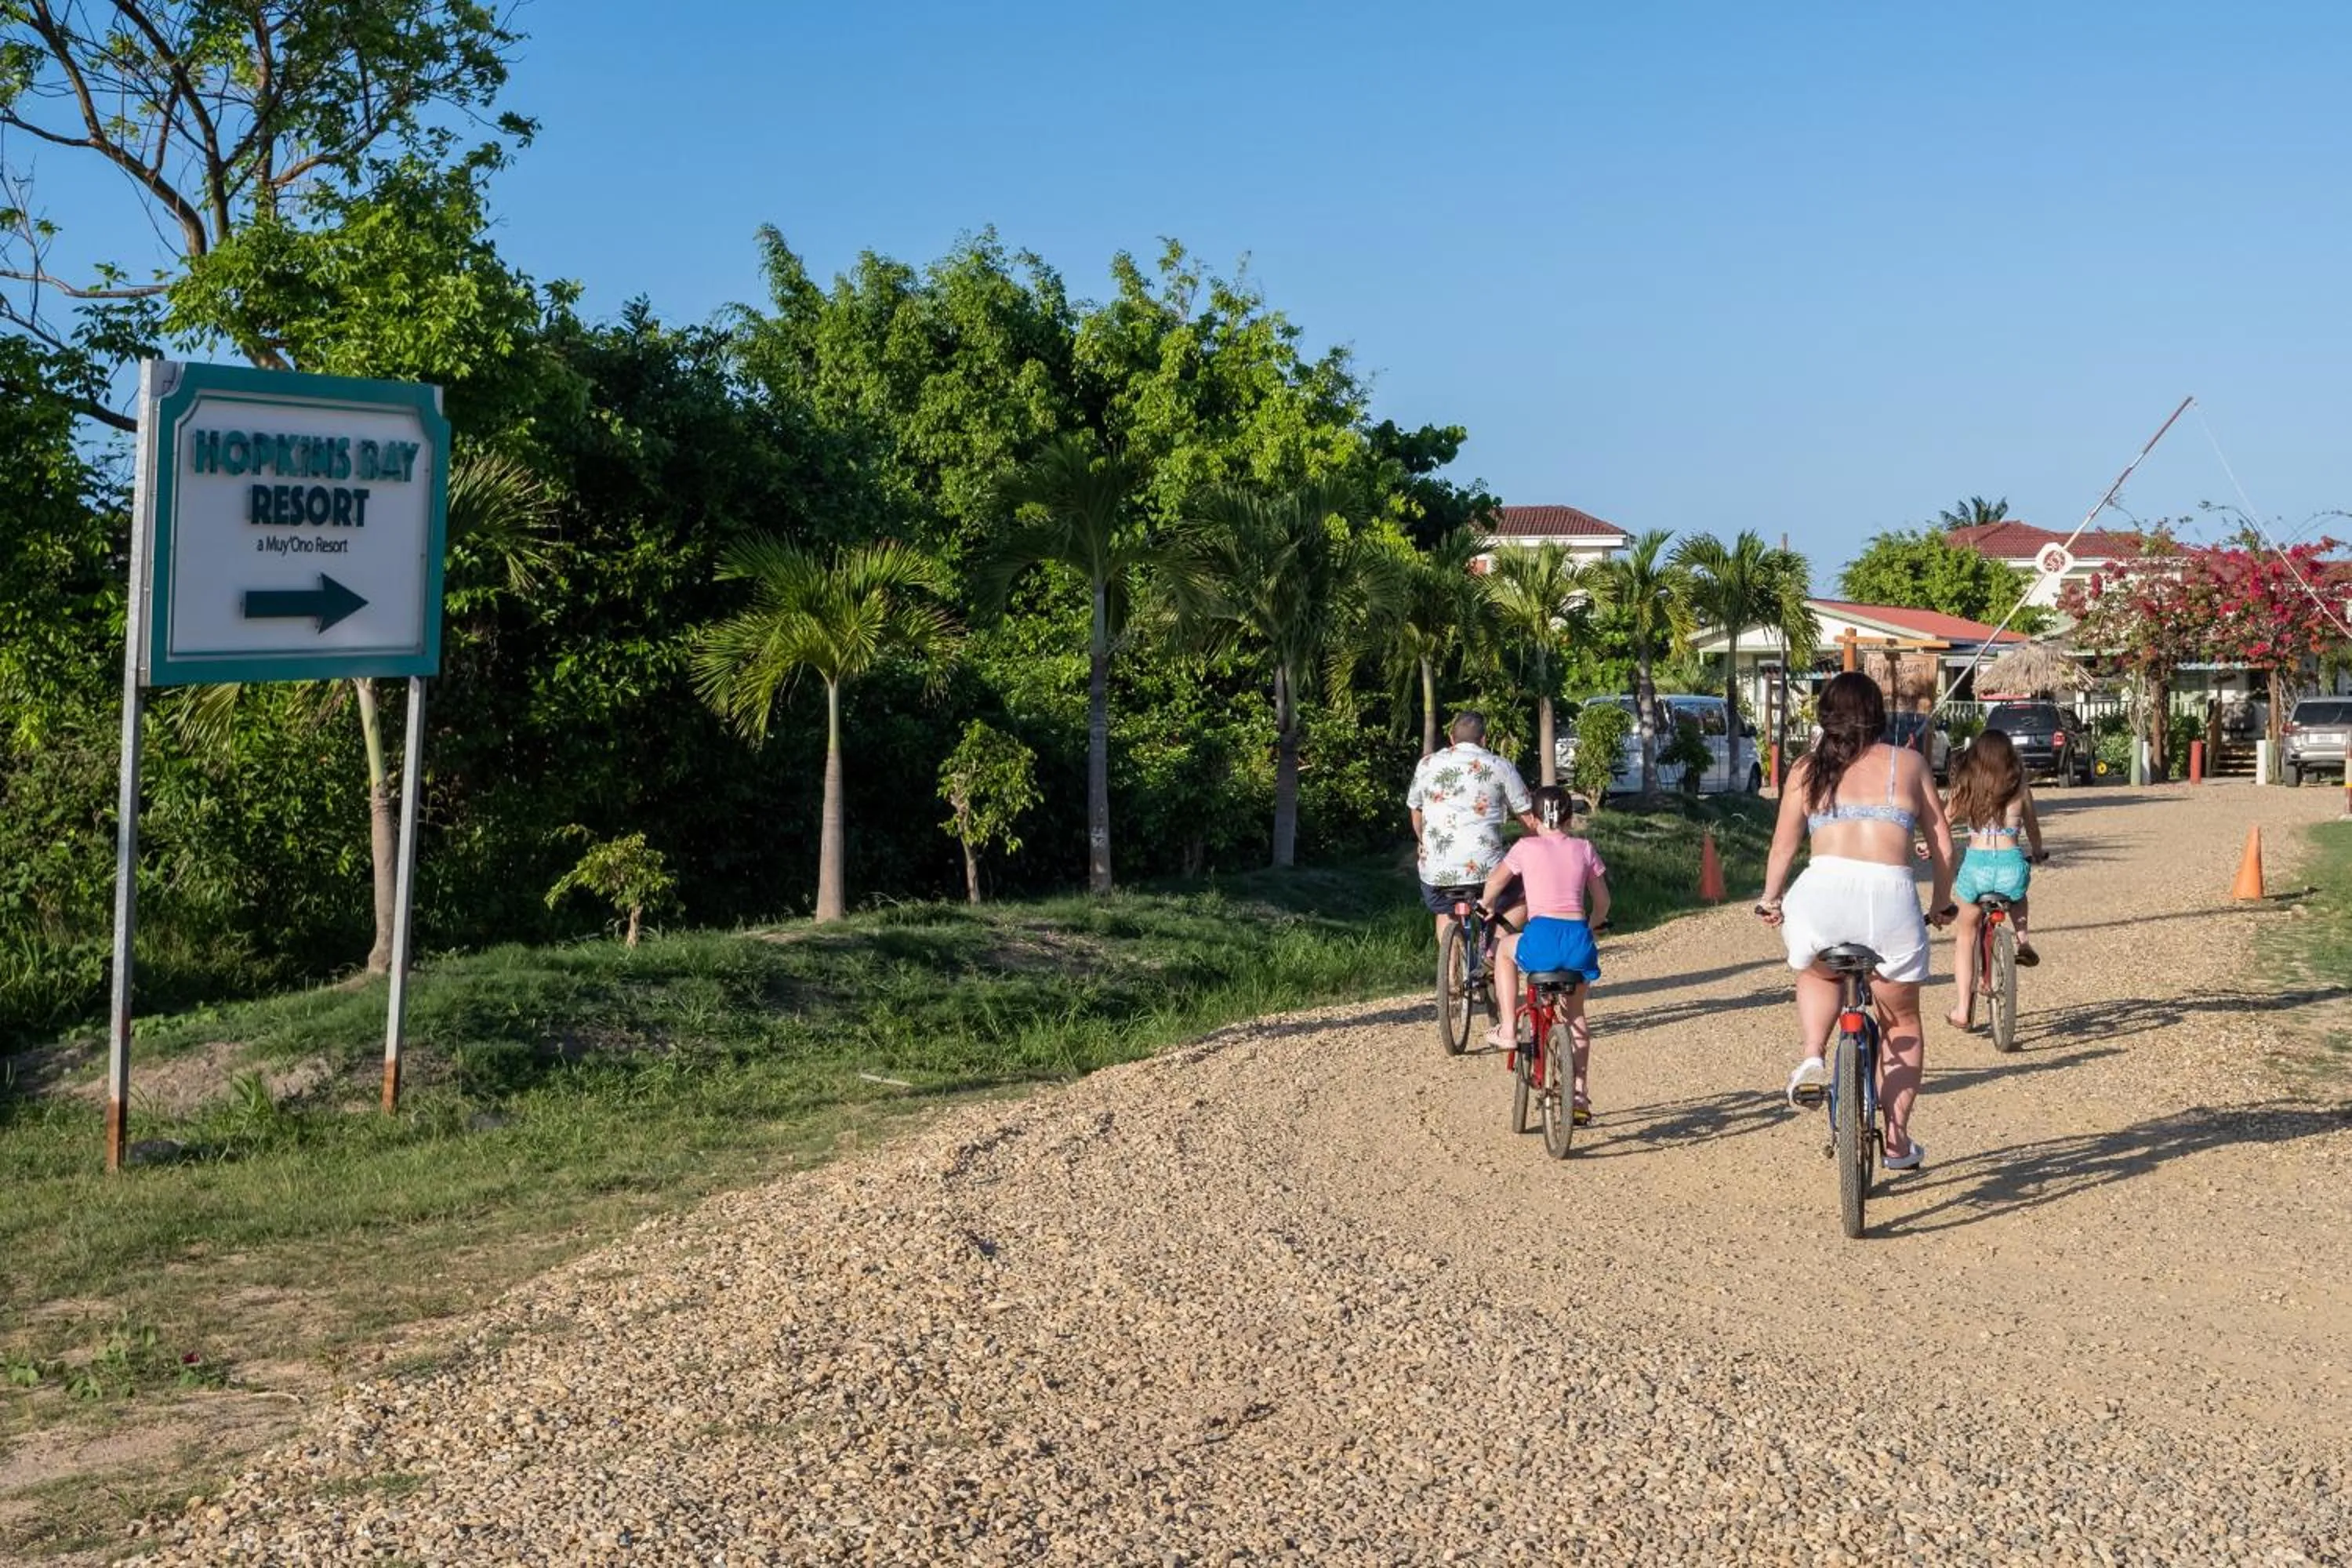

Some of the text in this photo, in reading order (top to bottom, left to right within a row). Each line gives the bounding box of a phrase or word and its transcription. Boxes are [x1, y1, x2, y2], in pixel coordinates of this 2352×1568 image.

[194, 430, 420, 482] HOPKINS BAY
[251, 485, 370, 527] RESORT
[256, 539, 264, 552] a
[315, 536, 348, 553] Resort
